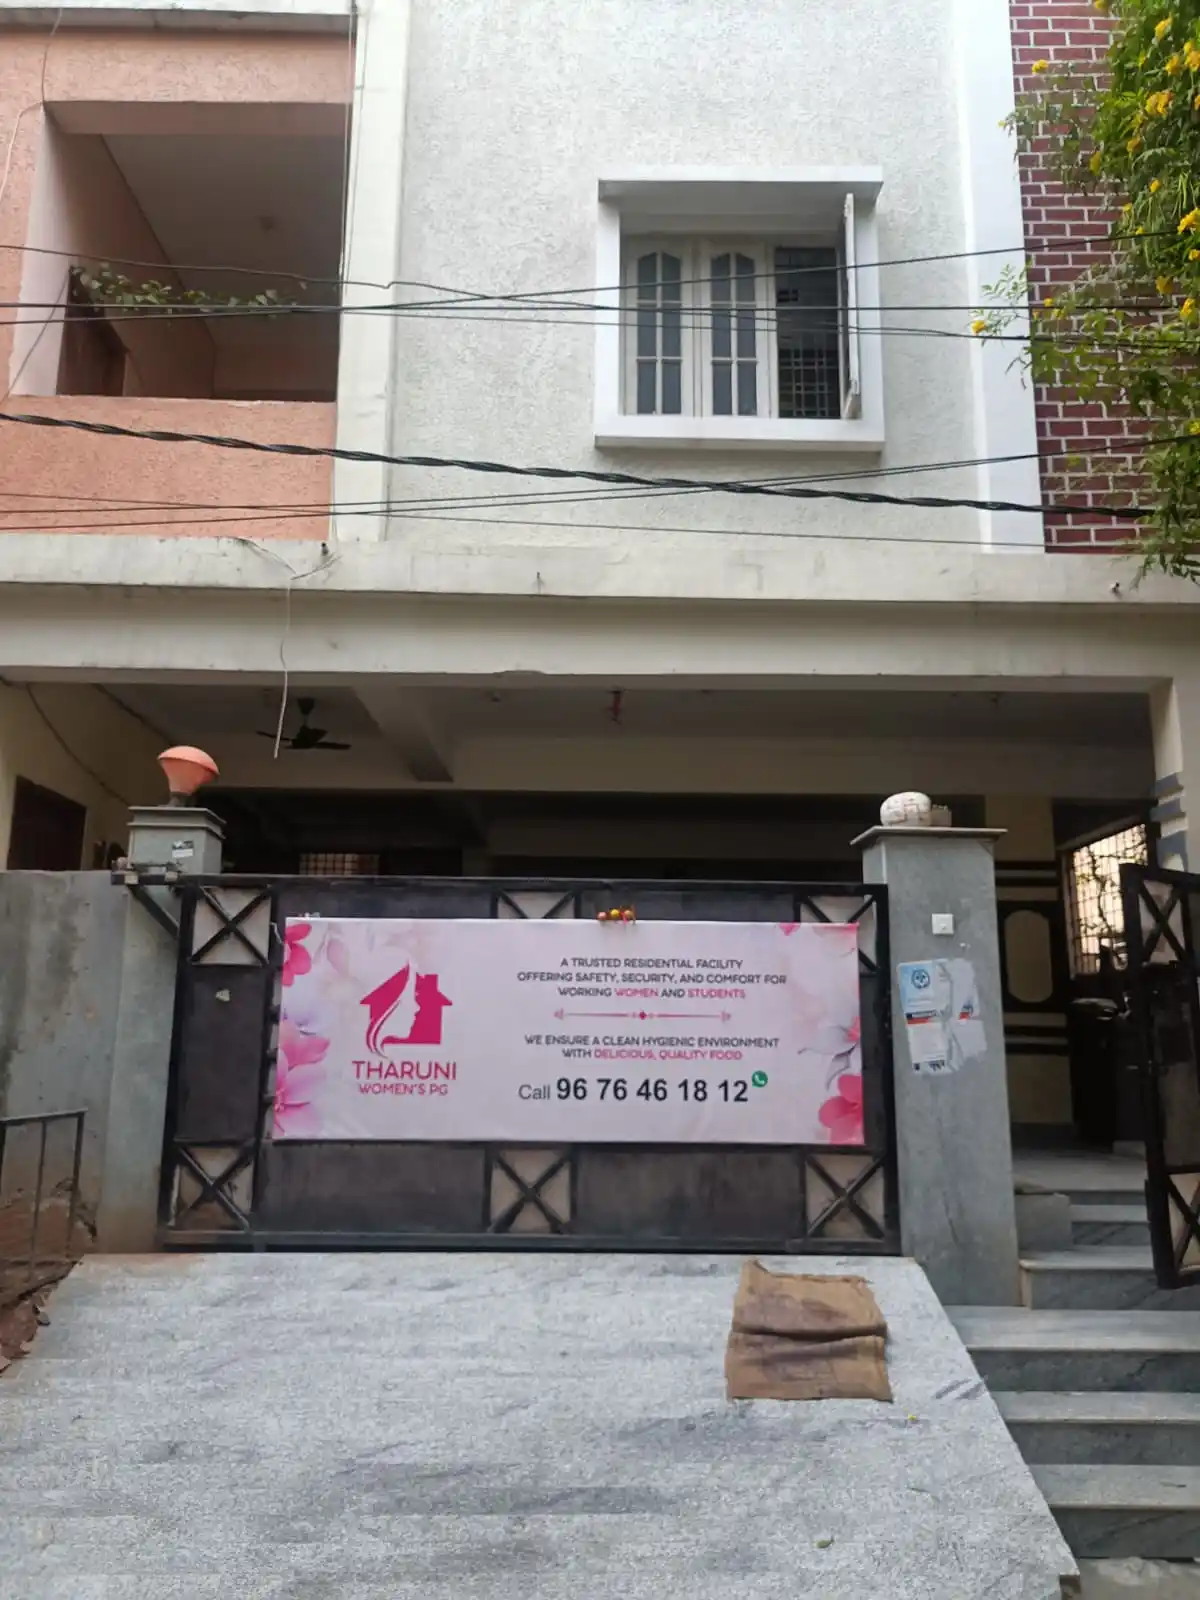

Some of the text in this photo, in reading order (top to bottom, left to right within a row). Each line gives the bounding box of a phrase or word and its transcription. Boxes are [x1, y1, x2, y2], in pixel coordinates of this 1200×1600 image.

[560, 957, 743, 970] A TRUSTED RESIDENTIAL FACILITY
[517, 971, 787, 985] OFFERING SAFETY, SECURITY, AND COMFORT FOR
[558, 986, 746, 999] WORKING WOMEN AND STUDENTS
[524, 1034, 779, 1048] WE ENSURE A CLEAN HYGIENIC ENVIRONMENT
[562, 1047, 742, 1060] WITH DELICIOUS, QUALITY FOOD
[352, 1060, 456, 1080] THARUNI
[358, 1083, 449, 1096] WOMEN'S PG
[518, 1077, 748, 1102] Call 96 76 46 18 12
